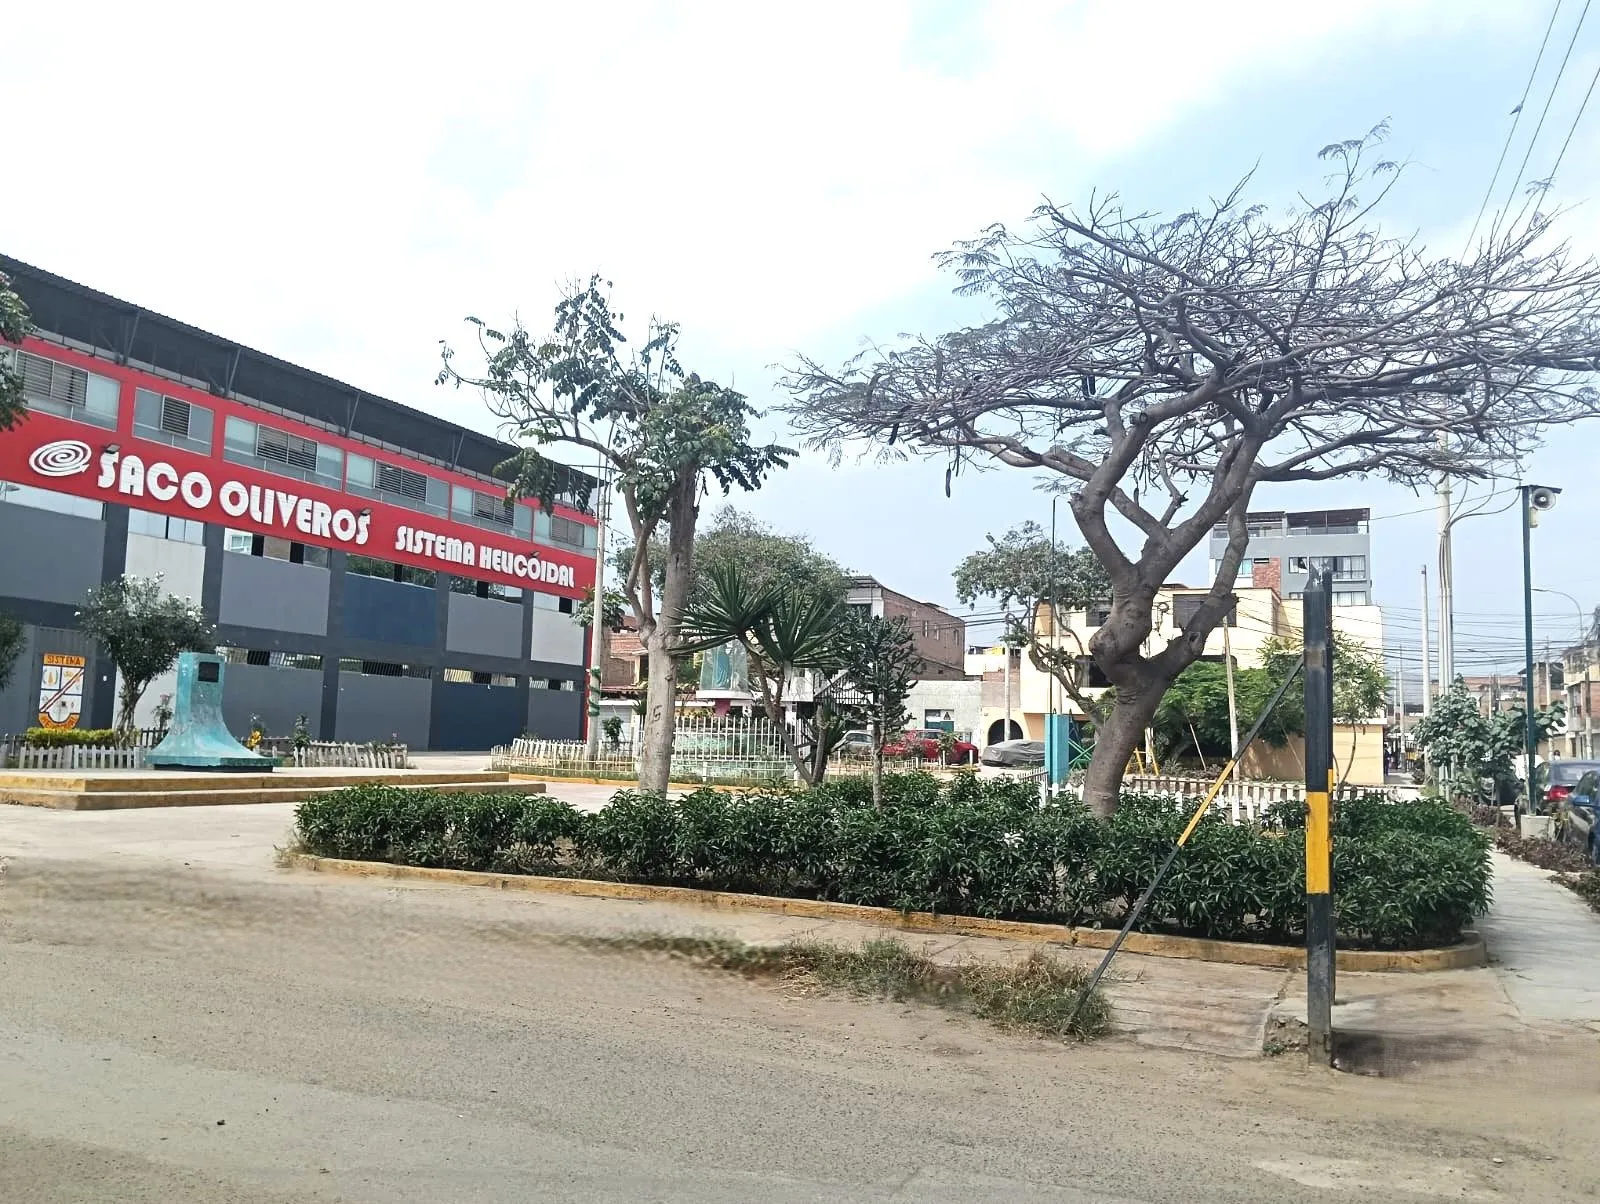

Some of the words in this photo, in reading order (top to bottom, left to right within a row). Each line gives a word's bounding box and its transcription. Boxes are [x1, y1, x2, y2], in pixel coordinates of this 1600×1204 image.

[98, 451, 213, 509] SACO
[219, 480, 371, 545] OLIVEROS
[395, 525, 476, 566] SISTEMA
[47, 655, 81, 665] SISTEMA
